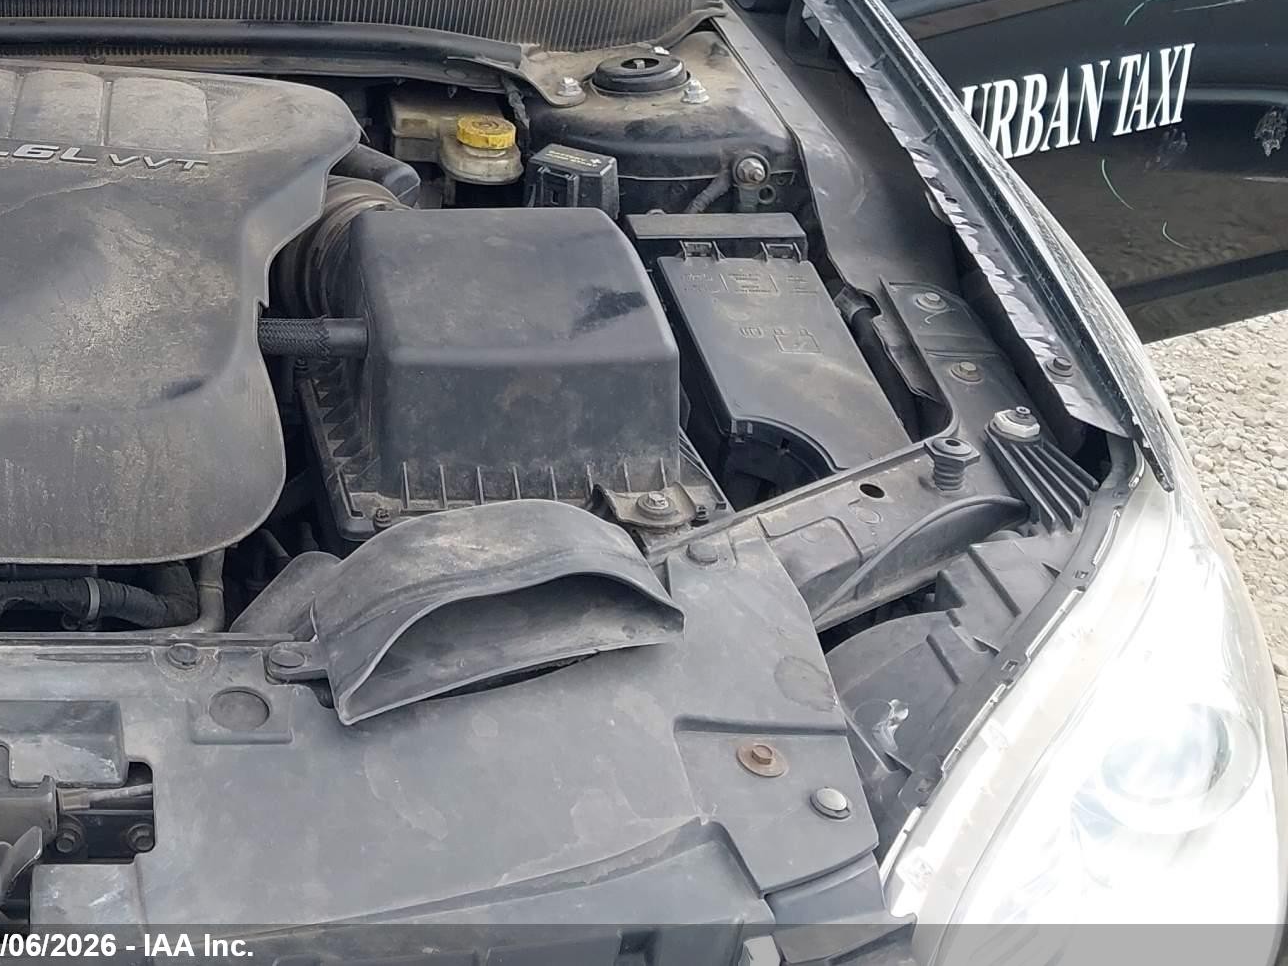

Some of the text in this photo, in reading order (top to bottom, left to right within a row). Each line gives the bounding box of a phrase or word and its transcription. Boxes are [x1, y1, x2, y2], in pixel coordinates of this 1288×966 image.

[961, 43, 1196, 160] URBAN TAXI
[108, 153, 209, 172] VVT
